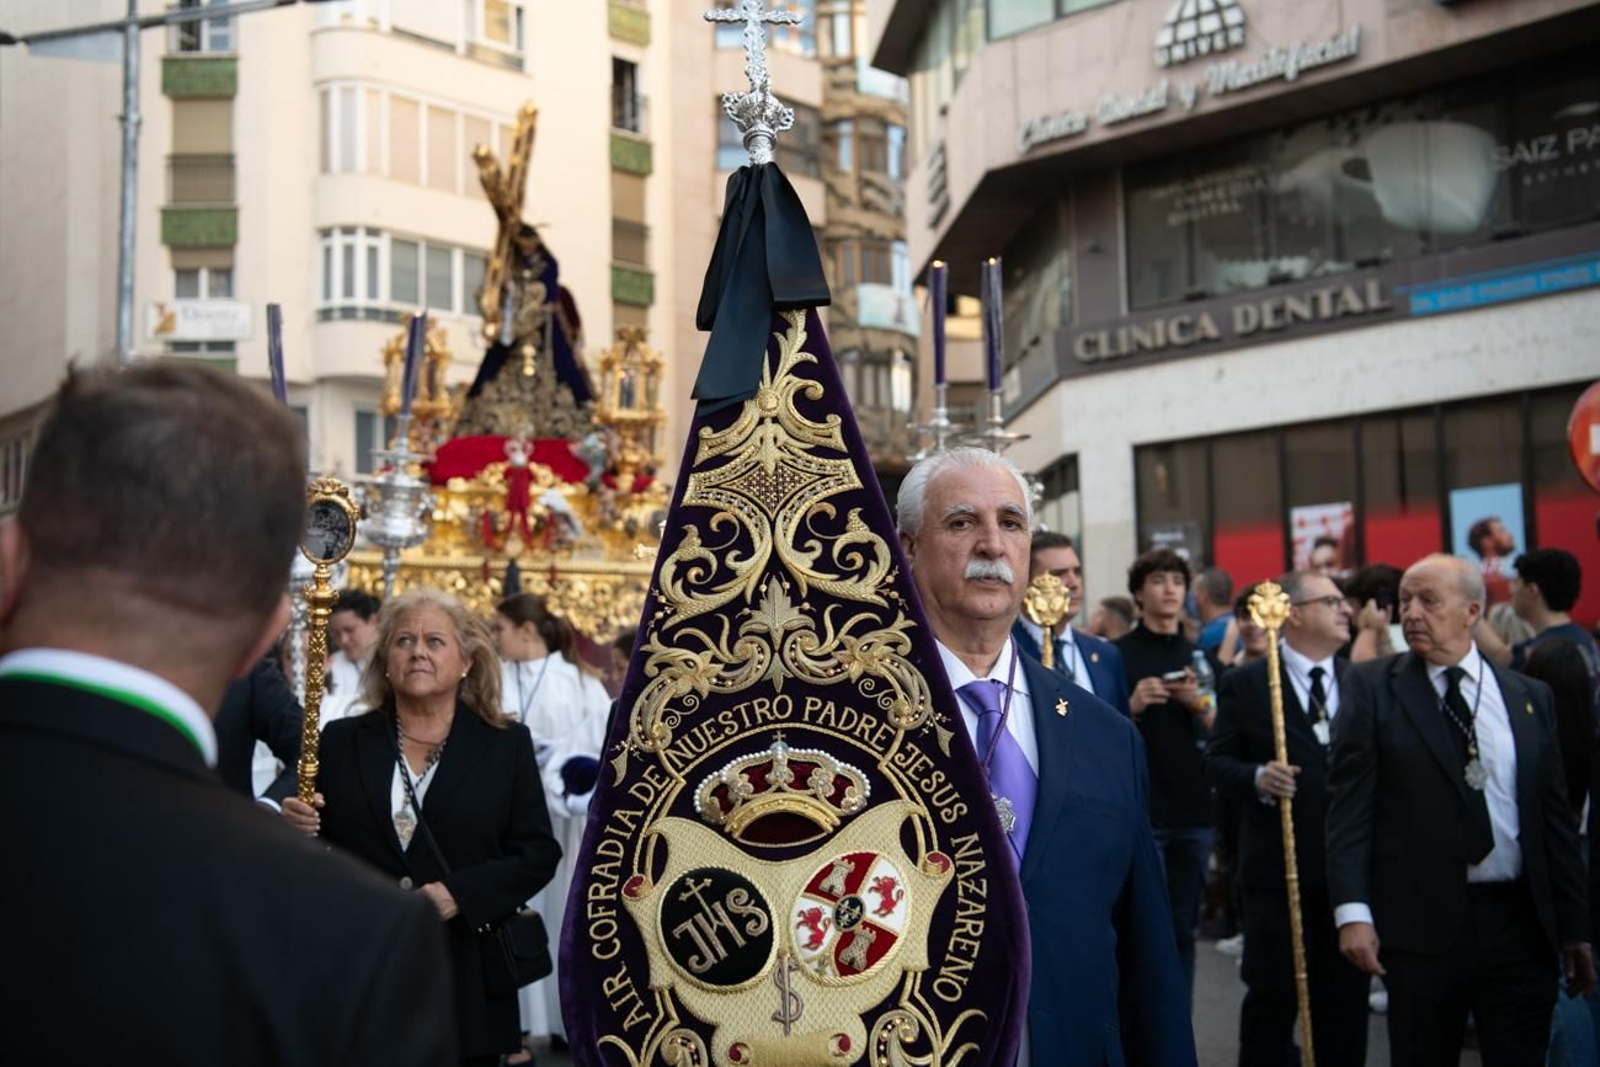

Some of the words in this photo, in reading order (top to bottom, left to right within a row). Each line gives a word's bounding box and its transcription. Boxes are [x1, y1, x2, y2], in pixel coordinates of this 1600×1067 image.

[1155, 25, 1245, 67] UNIVER
[1074, 311, 1220, 362] CLINICA
[1232, 279, 1388, 335] DENTAL
[586, 808, 644, 960] COFRADIA
[628, 765, 671, 806] DE
[666, 693, 793, 769] NUESTRO
[802, 696, 896, 751] PADRE
[893, 742, 969, 824] JESUS
[932, 832, 987, 1003] NAZARENO
